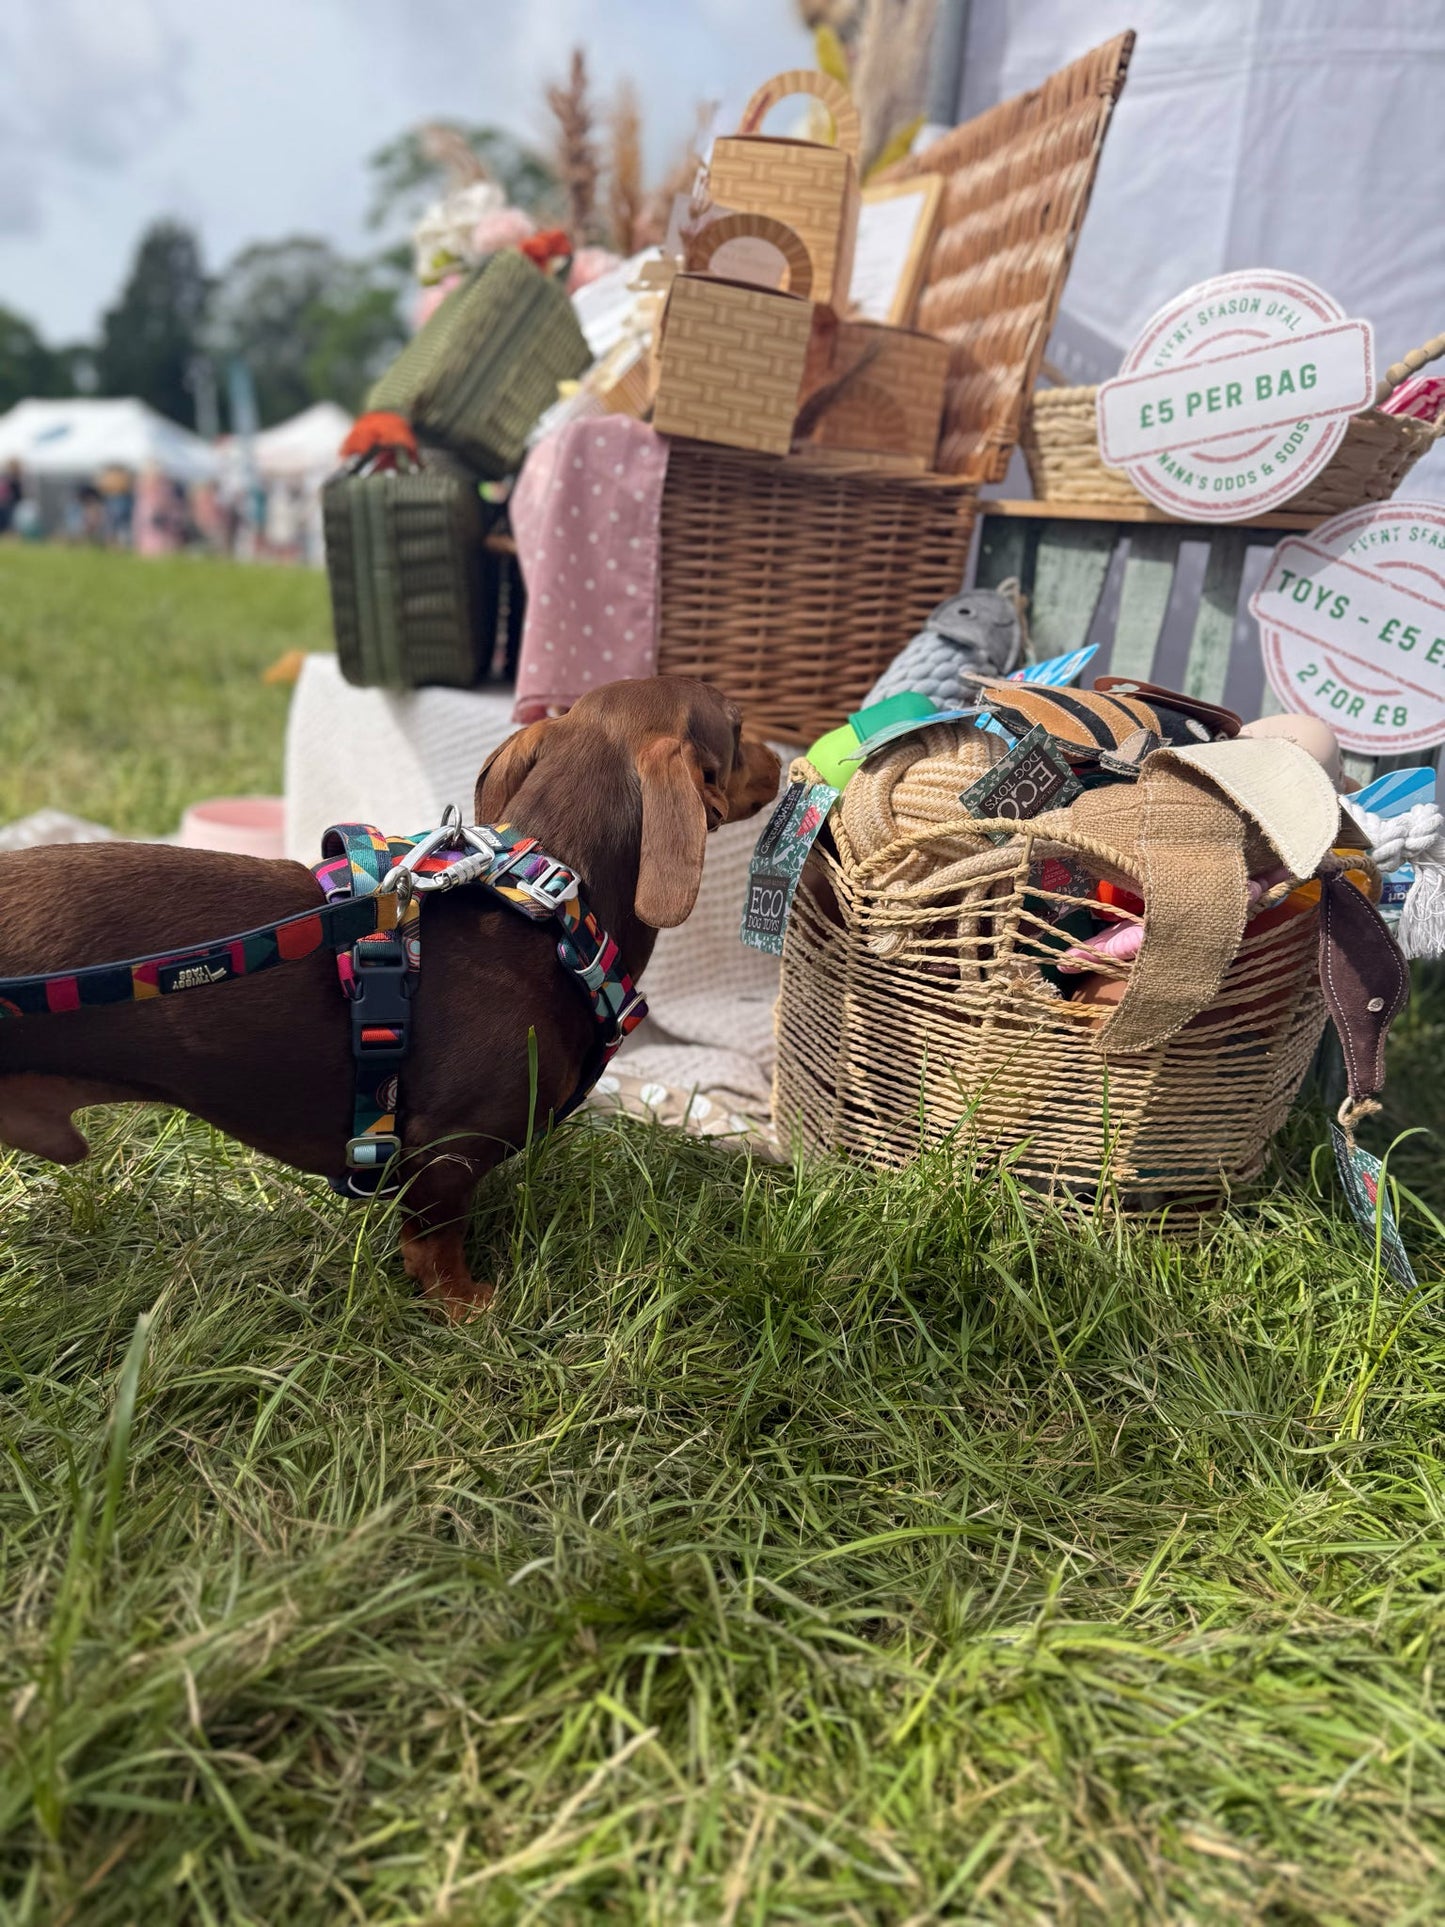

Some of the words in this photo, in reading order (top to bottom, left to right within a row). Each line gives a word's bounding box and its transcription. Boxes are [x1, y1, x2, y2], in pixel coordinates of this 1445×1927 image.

[1154, 322, 1193, 369] EVENT
[1197, 297, 1262, 326] SEASON
[1265, 299, 1302, 331] DEAL
[1139, 398, 1175, 430] £5
[1186, 381, 1244, 418] PER
[1255, 362, 1319, 402] BAG
[1157, 451, 1209, 491] NANA'S
[1212, 470, 1257, 492] ODDS
[1261, 462, 1275, 476] &
[1274, 420, 1310, 464] SODS
[1349, 526, 1402, 553] EVENT
[1277, 569, 1351, 620] TOYS
[1358, 616, 1370, 624] -
[1377, 618, 1422, 652] £5
[1424, 637, 1445, 669] E
[1296, 663, 1319, 683] 2
[1314, 679, 1366, 718] FOR
[1372, 705, 1409, 728] £8
[1014, 750, 1041, 779] DOG
[985, 779, 1015, 811] TOYS
[747, 914, 762, 929] DOG
[762, 917, 780, 932] TOYS
[750, 886, 784, 918] ECO
